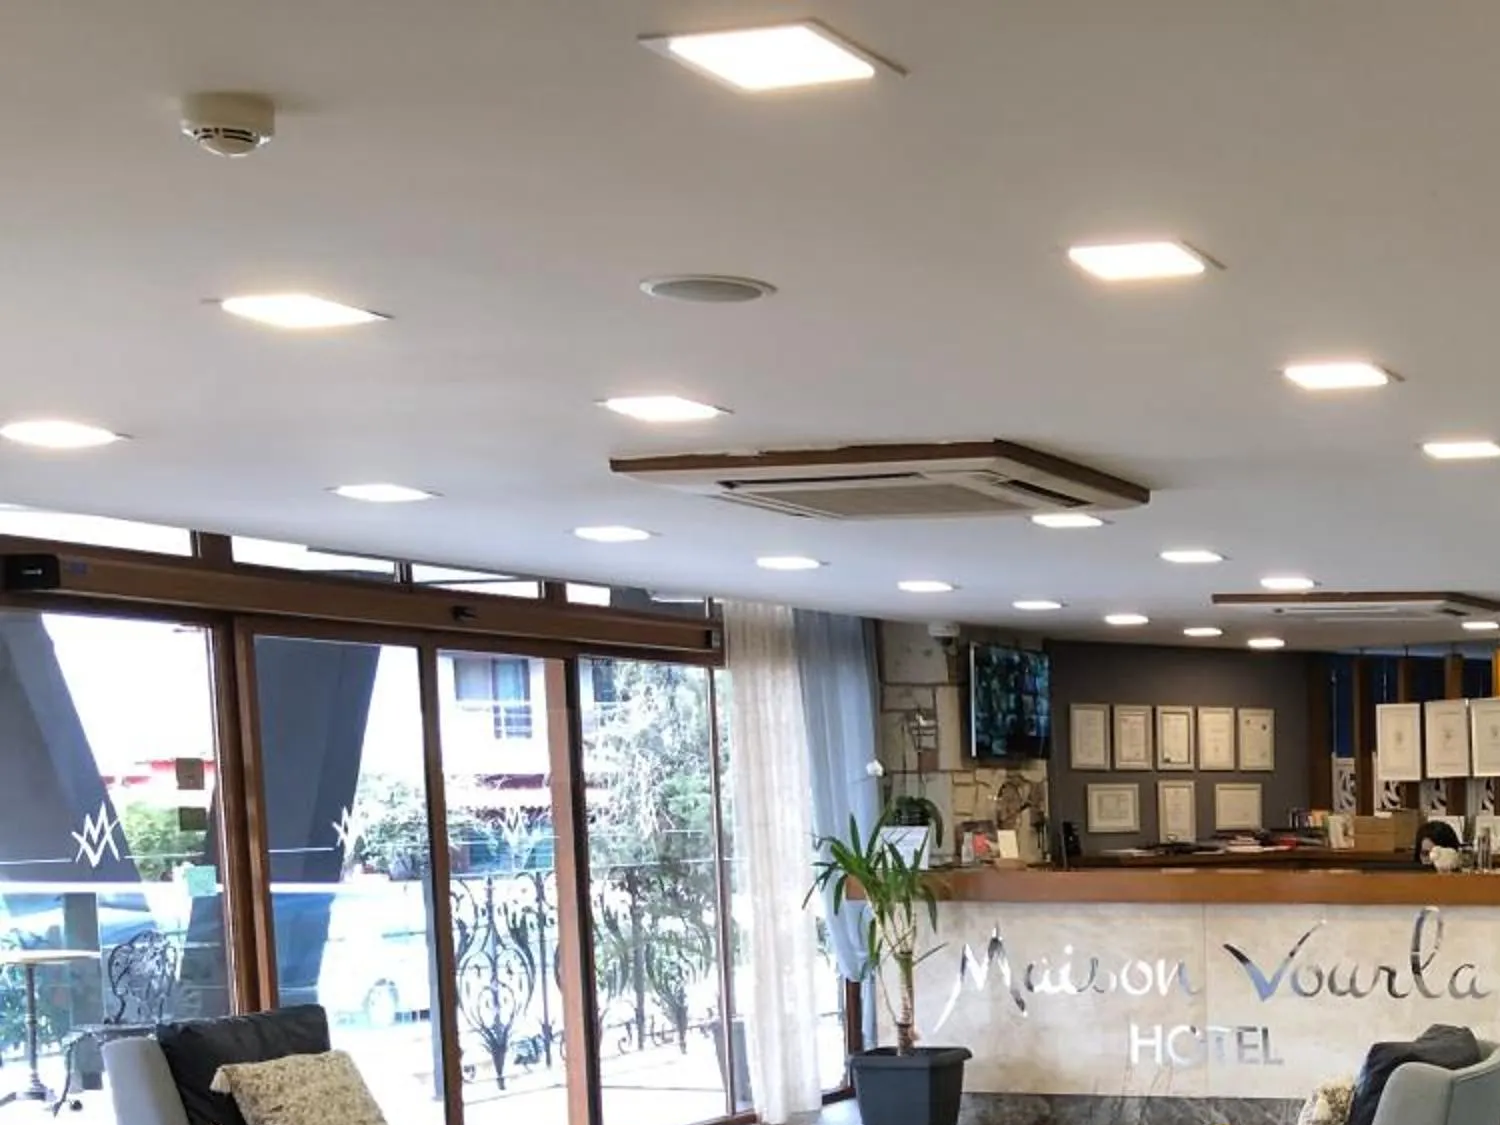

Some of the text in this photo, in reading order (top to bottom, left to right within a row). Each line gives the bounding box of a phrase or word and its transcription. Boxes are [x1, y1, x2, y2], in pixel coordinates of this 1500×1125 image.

[932, 905, 1492, 1033] Maison Vourla
[1129, 1023, 1285, 1066] HOTEL
